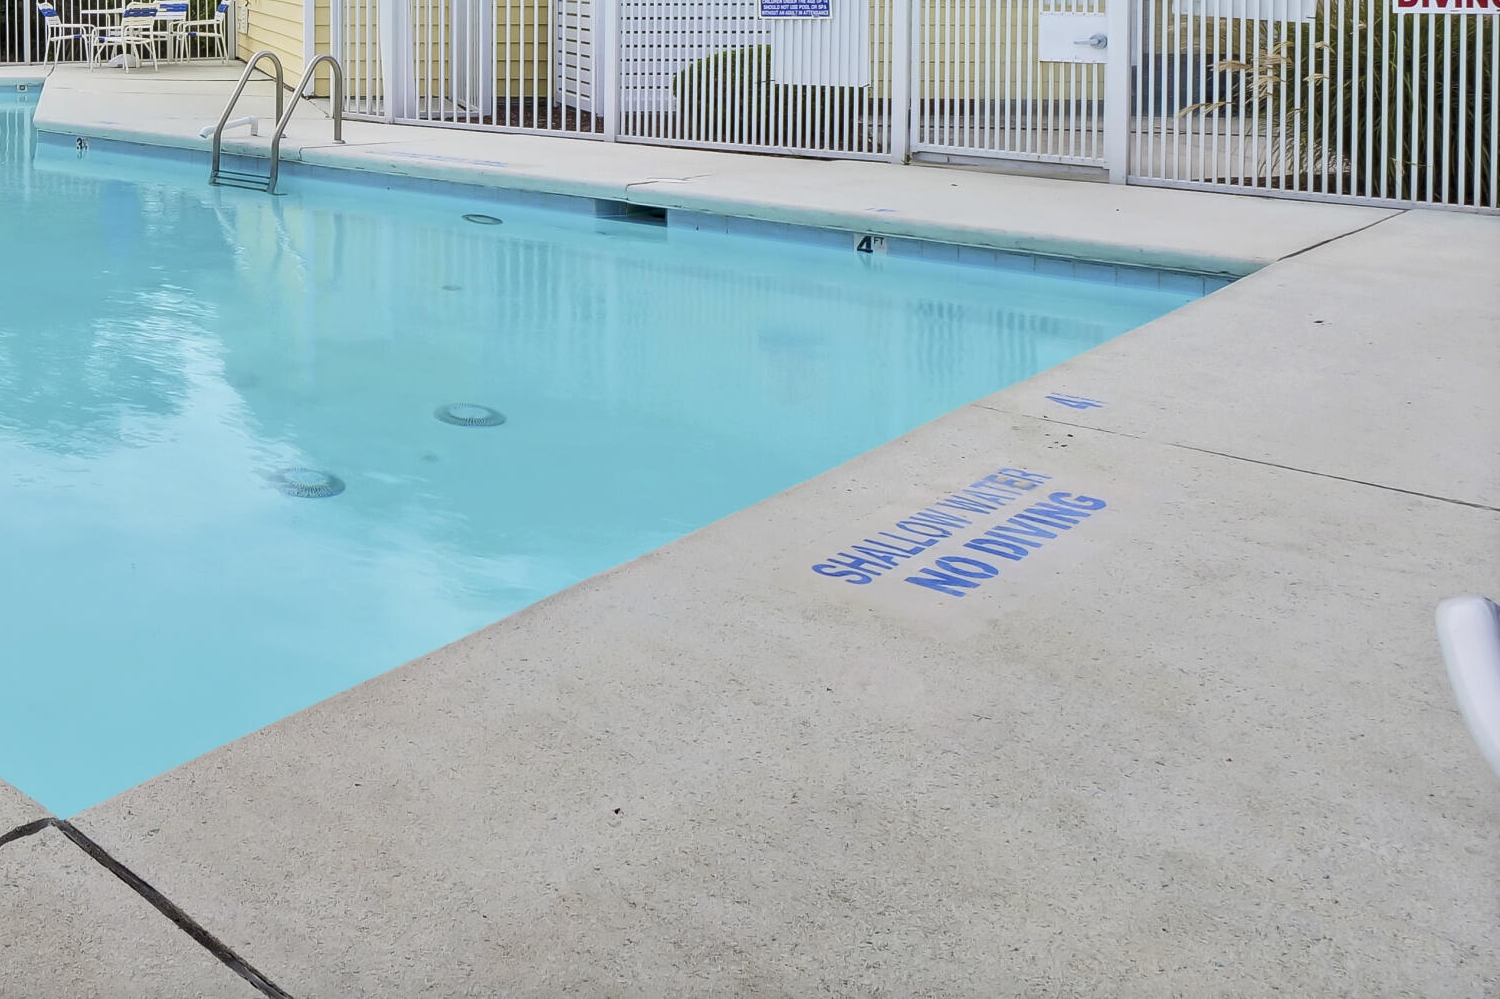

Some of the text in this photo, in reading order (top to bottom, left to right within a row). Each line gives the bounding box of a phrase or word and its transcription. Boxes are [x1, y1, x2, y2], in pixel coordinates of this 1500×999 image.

[857, 235, 874, 253] 4
[811, 467, 1053, 584] SHALLOW WATER
[903, 491, 1107, 597] NO DIVING
